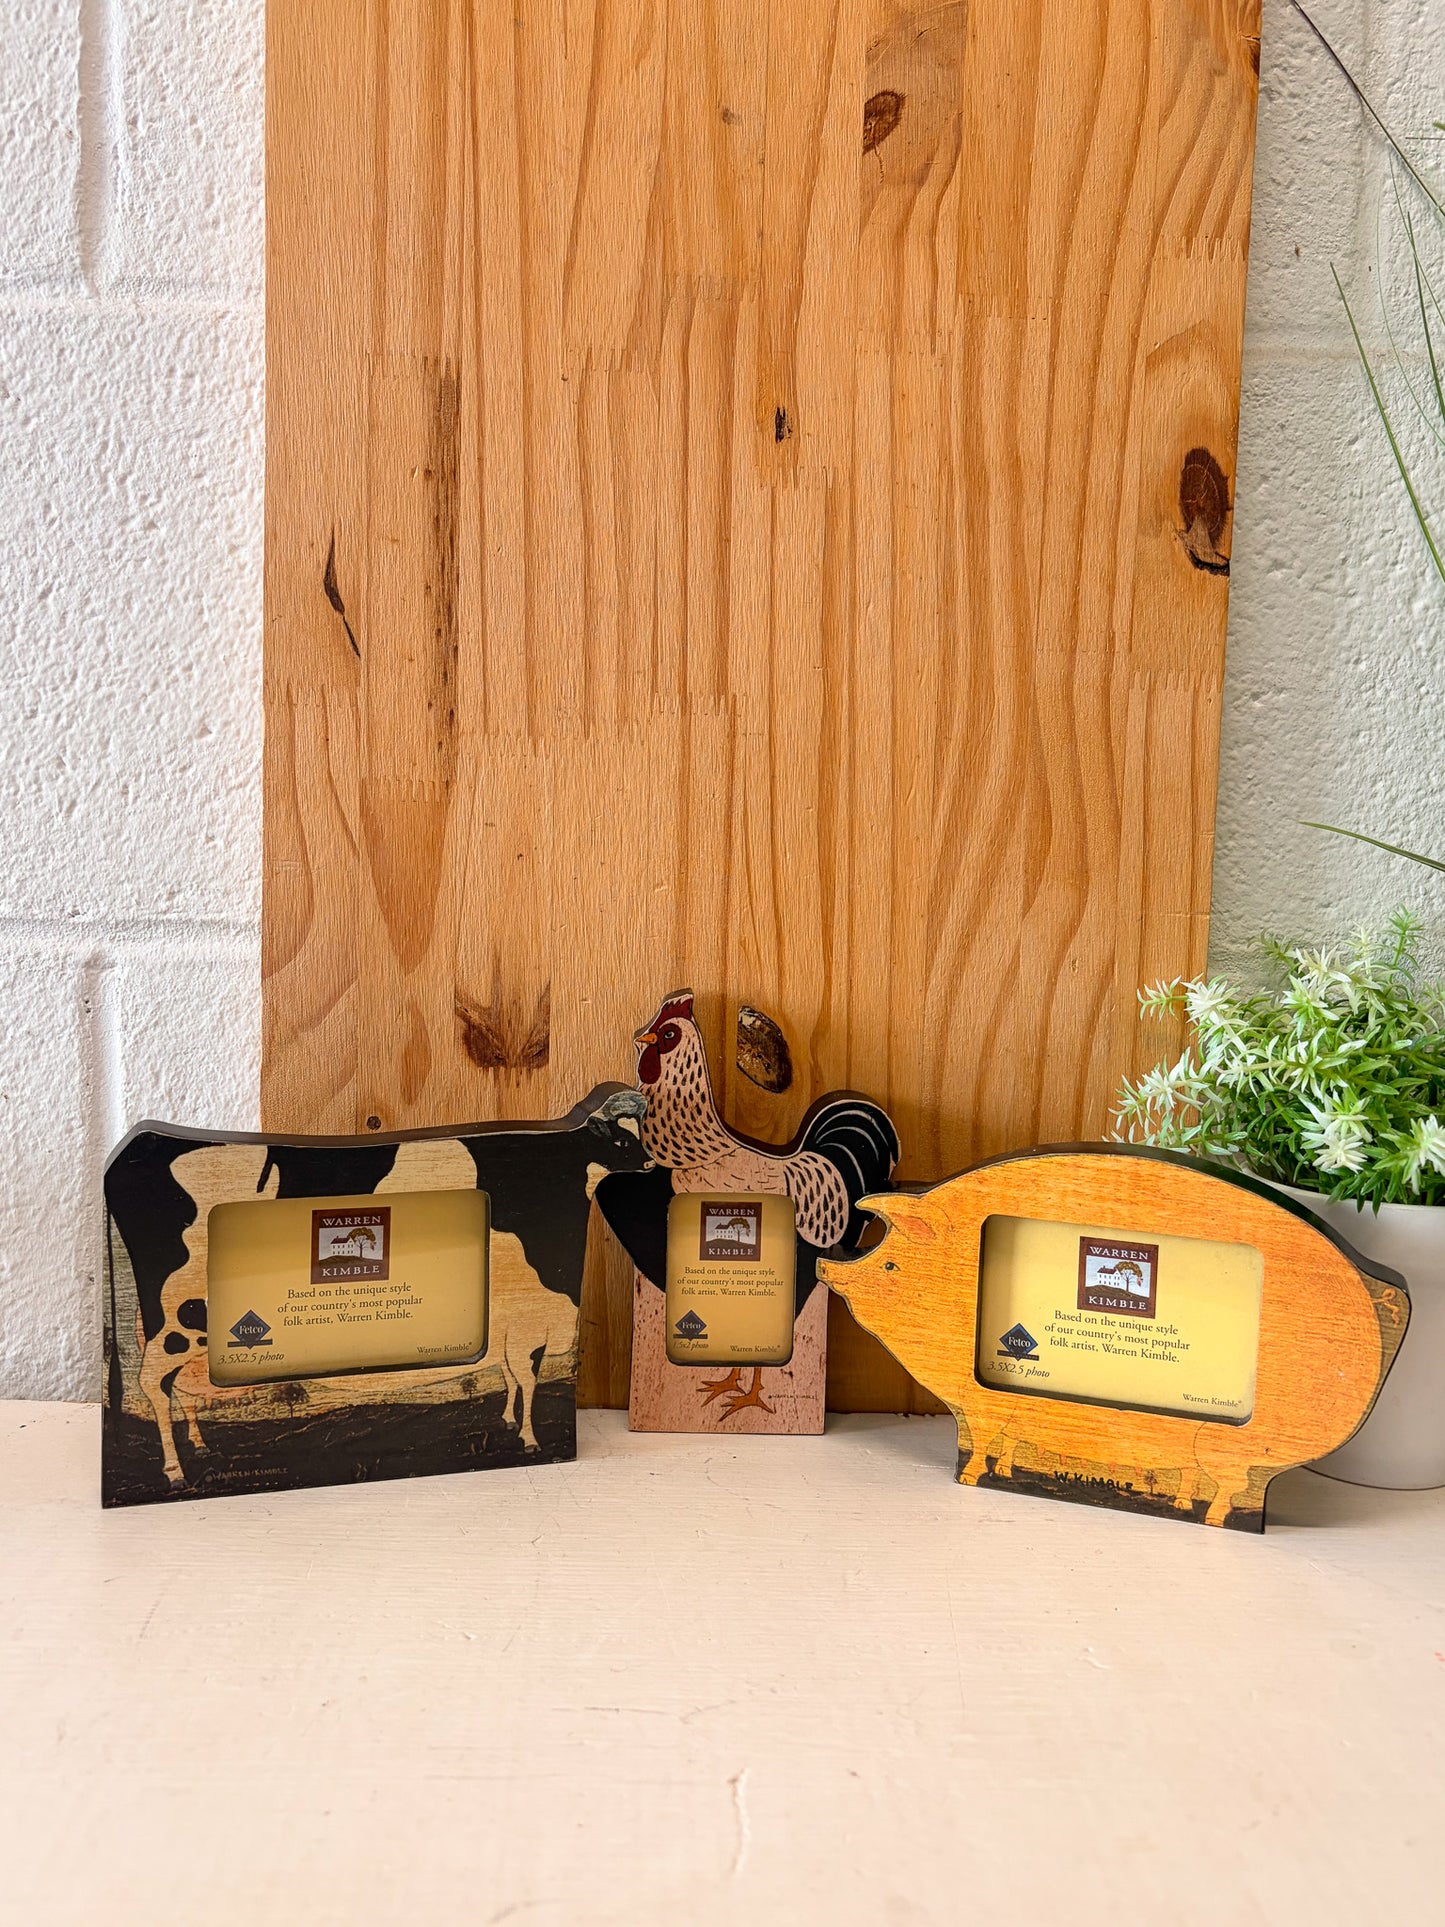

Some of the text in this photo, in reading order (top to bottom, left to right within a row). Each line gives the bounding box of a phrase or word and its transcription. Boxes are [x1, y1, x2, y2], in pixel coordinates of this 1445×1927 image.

[322, 1215, 381, 1226] WARREN
[1090, 1246, 1148, 1260] WARREN
[322, 1265, 380, 1277] KIMBLE
[719, 1267, 730, 1275] the
[733, 1268, 756, 1277] unique
[759, 1268, 775, 1277] style
[701, 1278, 734, 1286] country's
[756, 1279, 784, 1287] popular
[288, 1288, 315, 1298] Based
[335, 1286, 350, 1296] the
[354, 1285, 387, 1296] unique
[390, 1282, 411, 1294] style
[278, 1295, 423, 1313] of our country's most popular
[1088, 1296, 1146, 1310] KIMBLE
[283, 1316, 302, 1326] folk
[337, 1312, 372, 1323] Warren
[375, 1309, 413, 1320] Kimble.
[1055, 1310, 1081, 1322] Based
[1101, 1316, 1116, 1327] the
[1119, 1320, 1153, 1333] unique
[1156, 1325, 1178, 1336] style
[239, 1325, 264, 1335] Fetco
[1008, 1336, 1030, 1348] Fetco
[1045, 1323, 1190, 1350] of our country's most popular
[416, 1346, 442, 1354] Warren
[1050, 1336, 1068, 1347] folk
[1102, 1343, 1137, 1356] Warren
[1141, 1348, 1180, 1362] Kimble.
[258, 1351, 284, 1364] photo
[1025, 1366, 1050, 1378] photo
[1183, 1393, 1208, 1404] Warren
